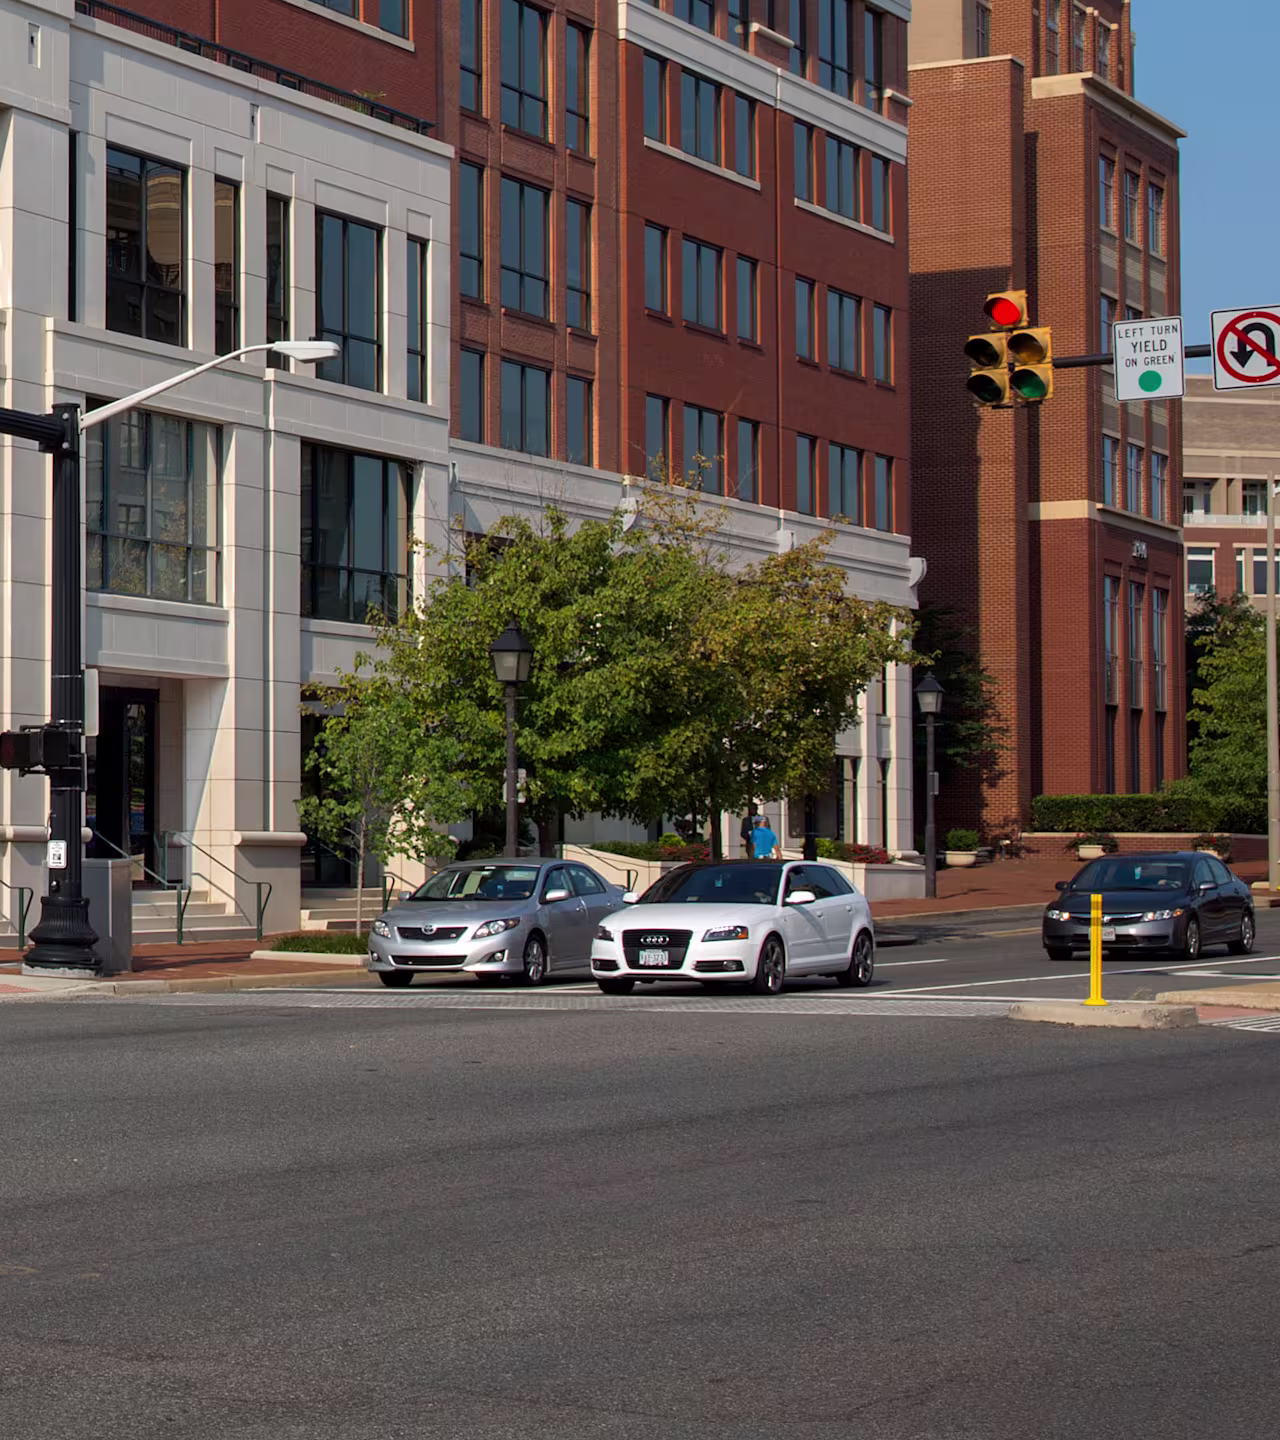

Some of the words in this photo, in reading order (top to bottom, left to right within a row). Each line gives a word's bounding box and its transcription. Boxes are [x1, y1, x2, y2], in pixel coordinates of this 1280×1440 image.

[1118, 327, 1144, 339] LEFT
[1151, 324, 1178, 336] TURN
[1131, 339, 1167, 353] YIELD
[1125, 358, 1138, 368] ON
[1143, 354, 1175, 366] GREEN
